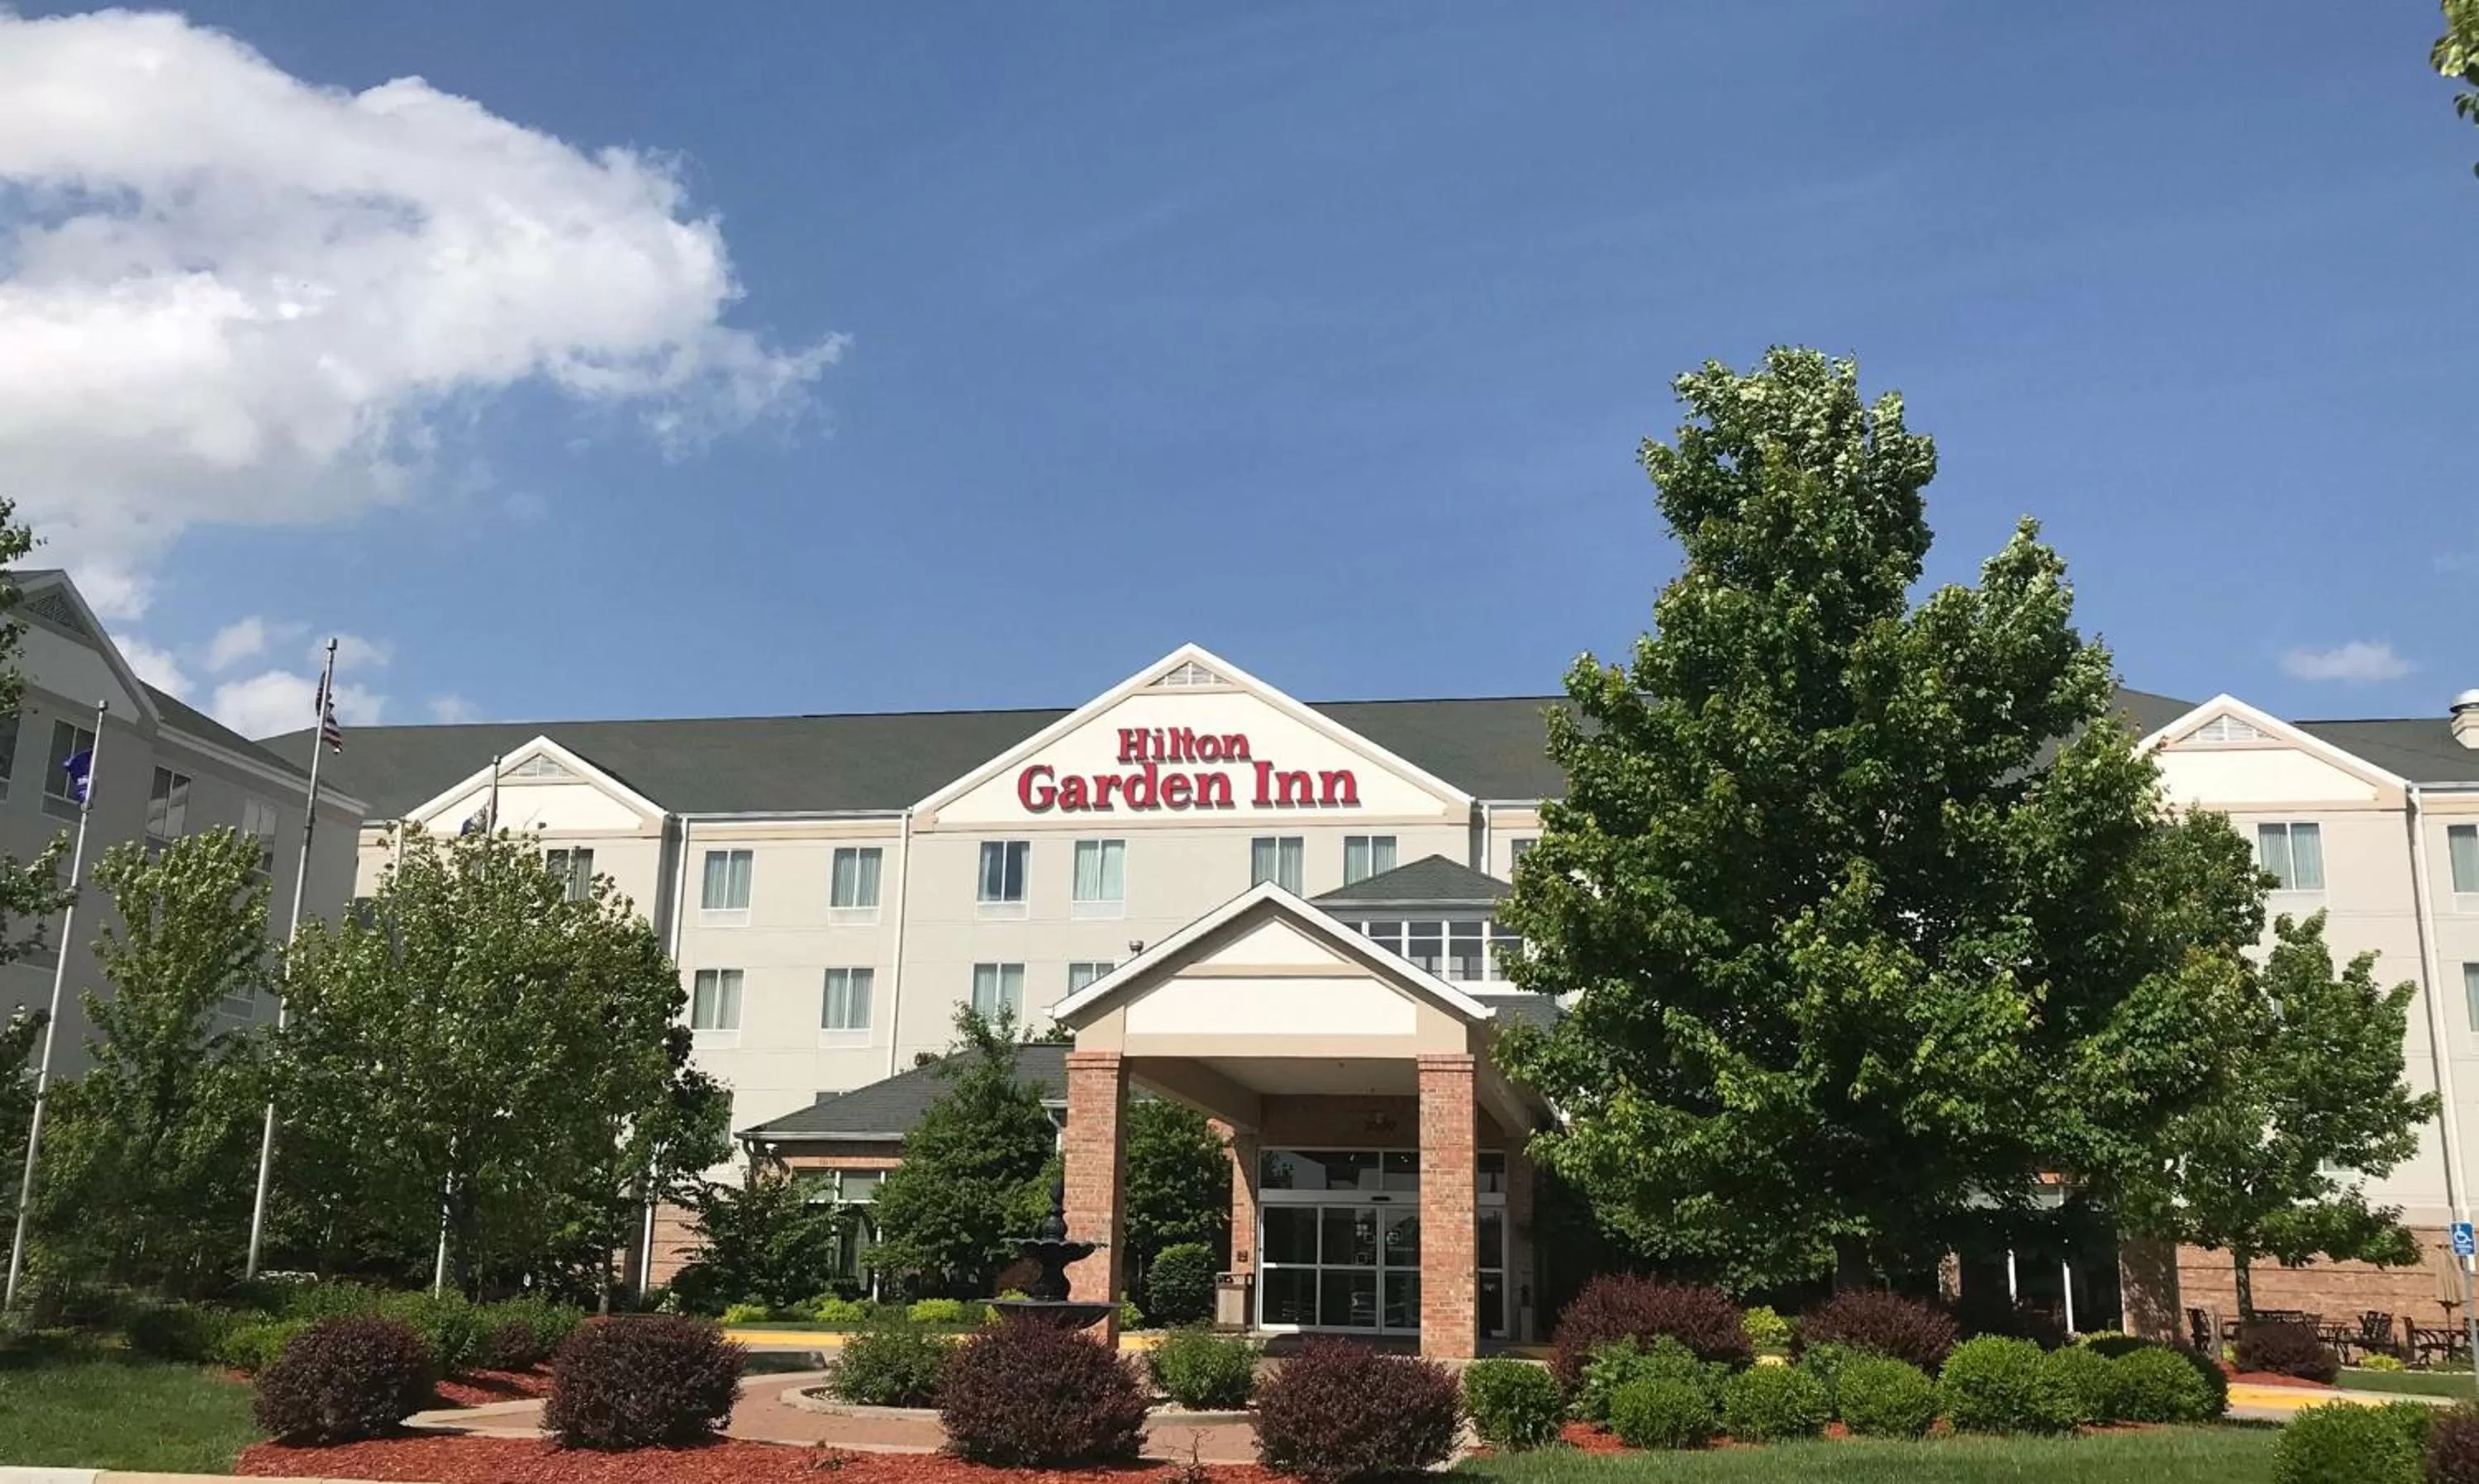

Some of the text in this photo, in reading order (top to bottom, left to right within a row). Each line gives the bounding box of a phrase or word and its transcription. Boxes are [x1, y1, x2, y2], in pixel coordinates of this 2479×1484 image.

[1117, 727, 1252, 764] Hilton
[1017, 760, 1362, 814] Garden Inn
